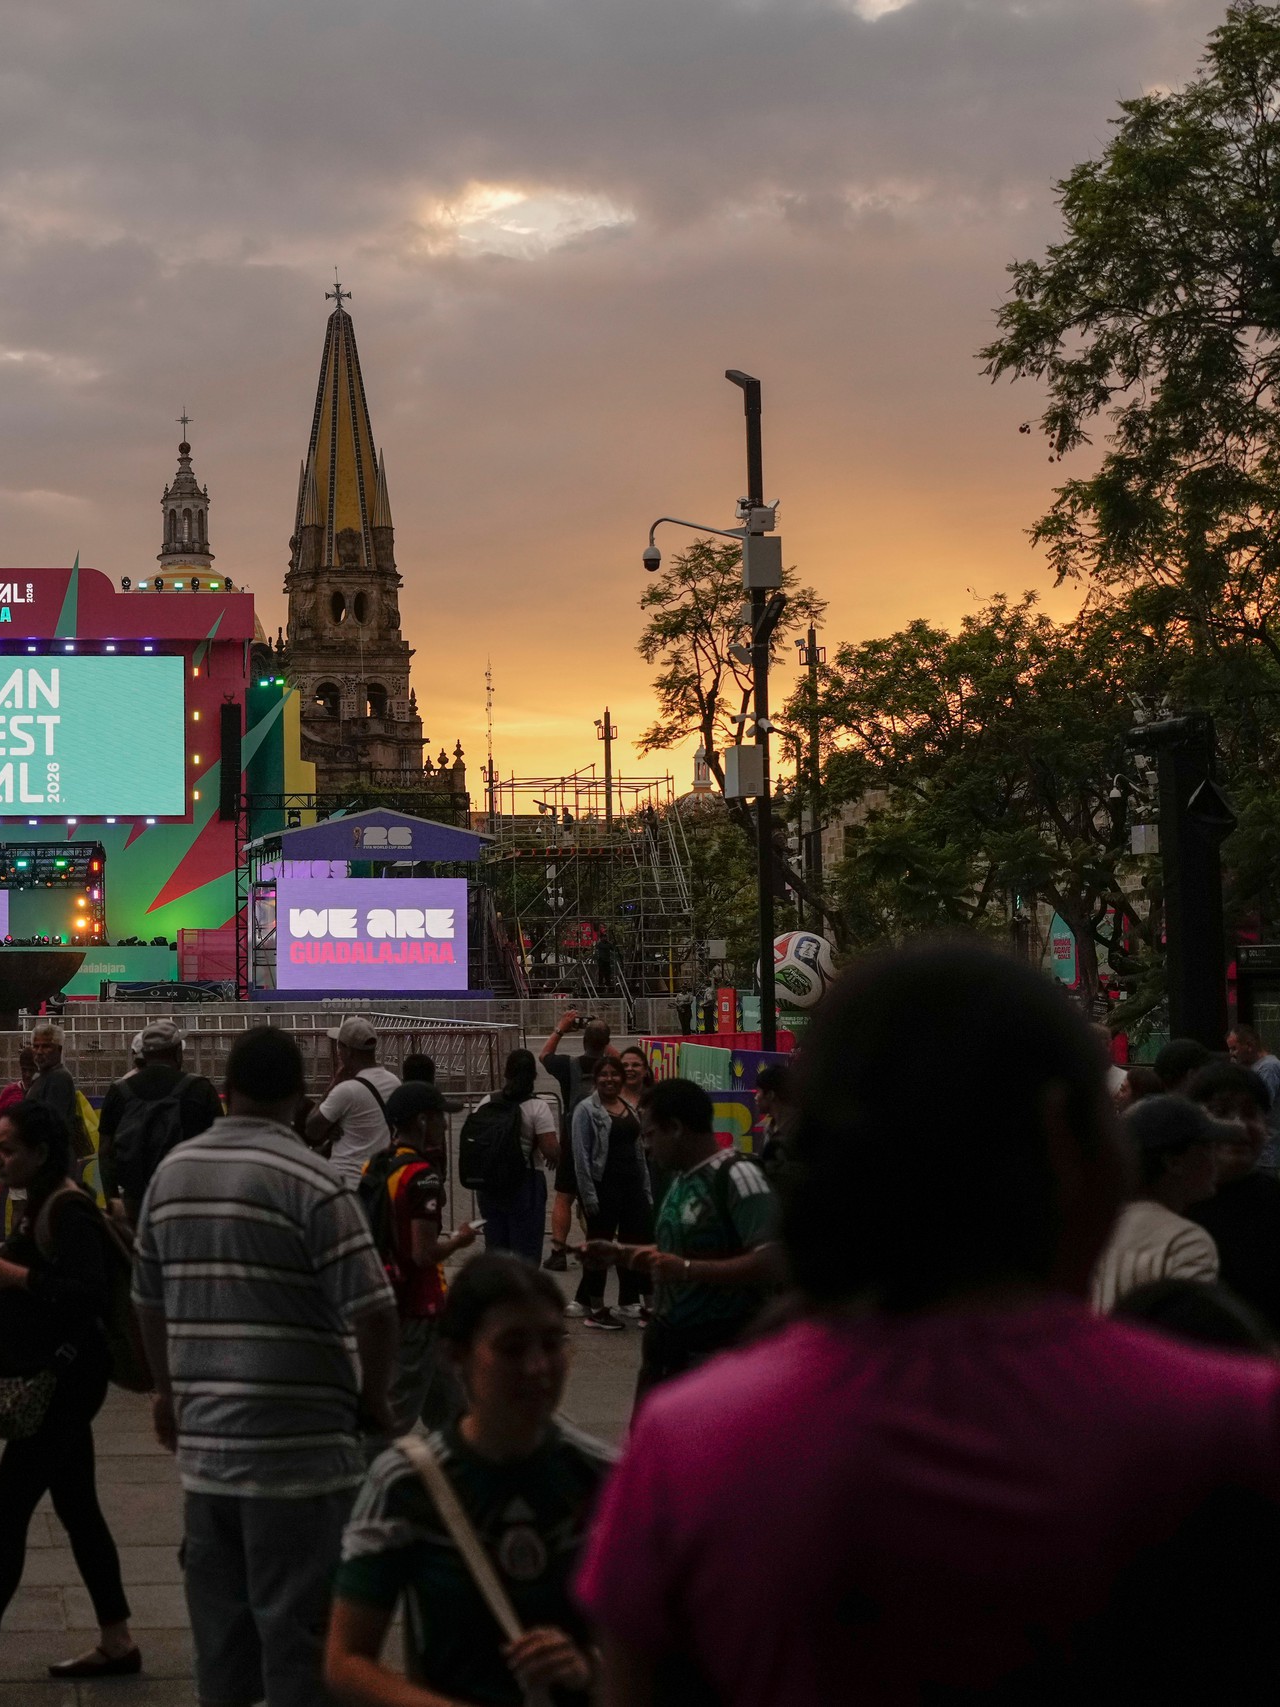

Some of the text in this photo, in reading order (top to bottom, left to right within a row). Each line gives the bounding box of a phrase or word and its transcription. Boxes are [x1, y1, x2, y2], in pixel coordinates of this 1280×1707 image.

[26, 583, 34, 603] 2026
[46, 762, 60, 803] 2026
[289, 908, 455, 938] WE ARE
[289, 941, 455, 965] GUADALAJARA
[78, 963, 126, 975] uadalajara
